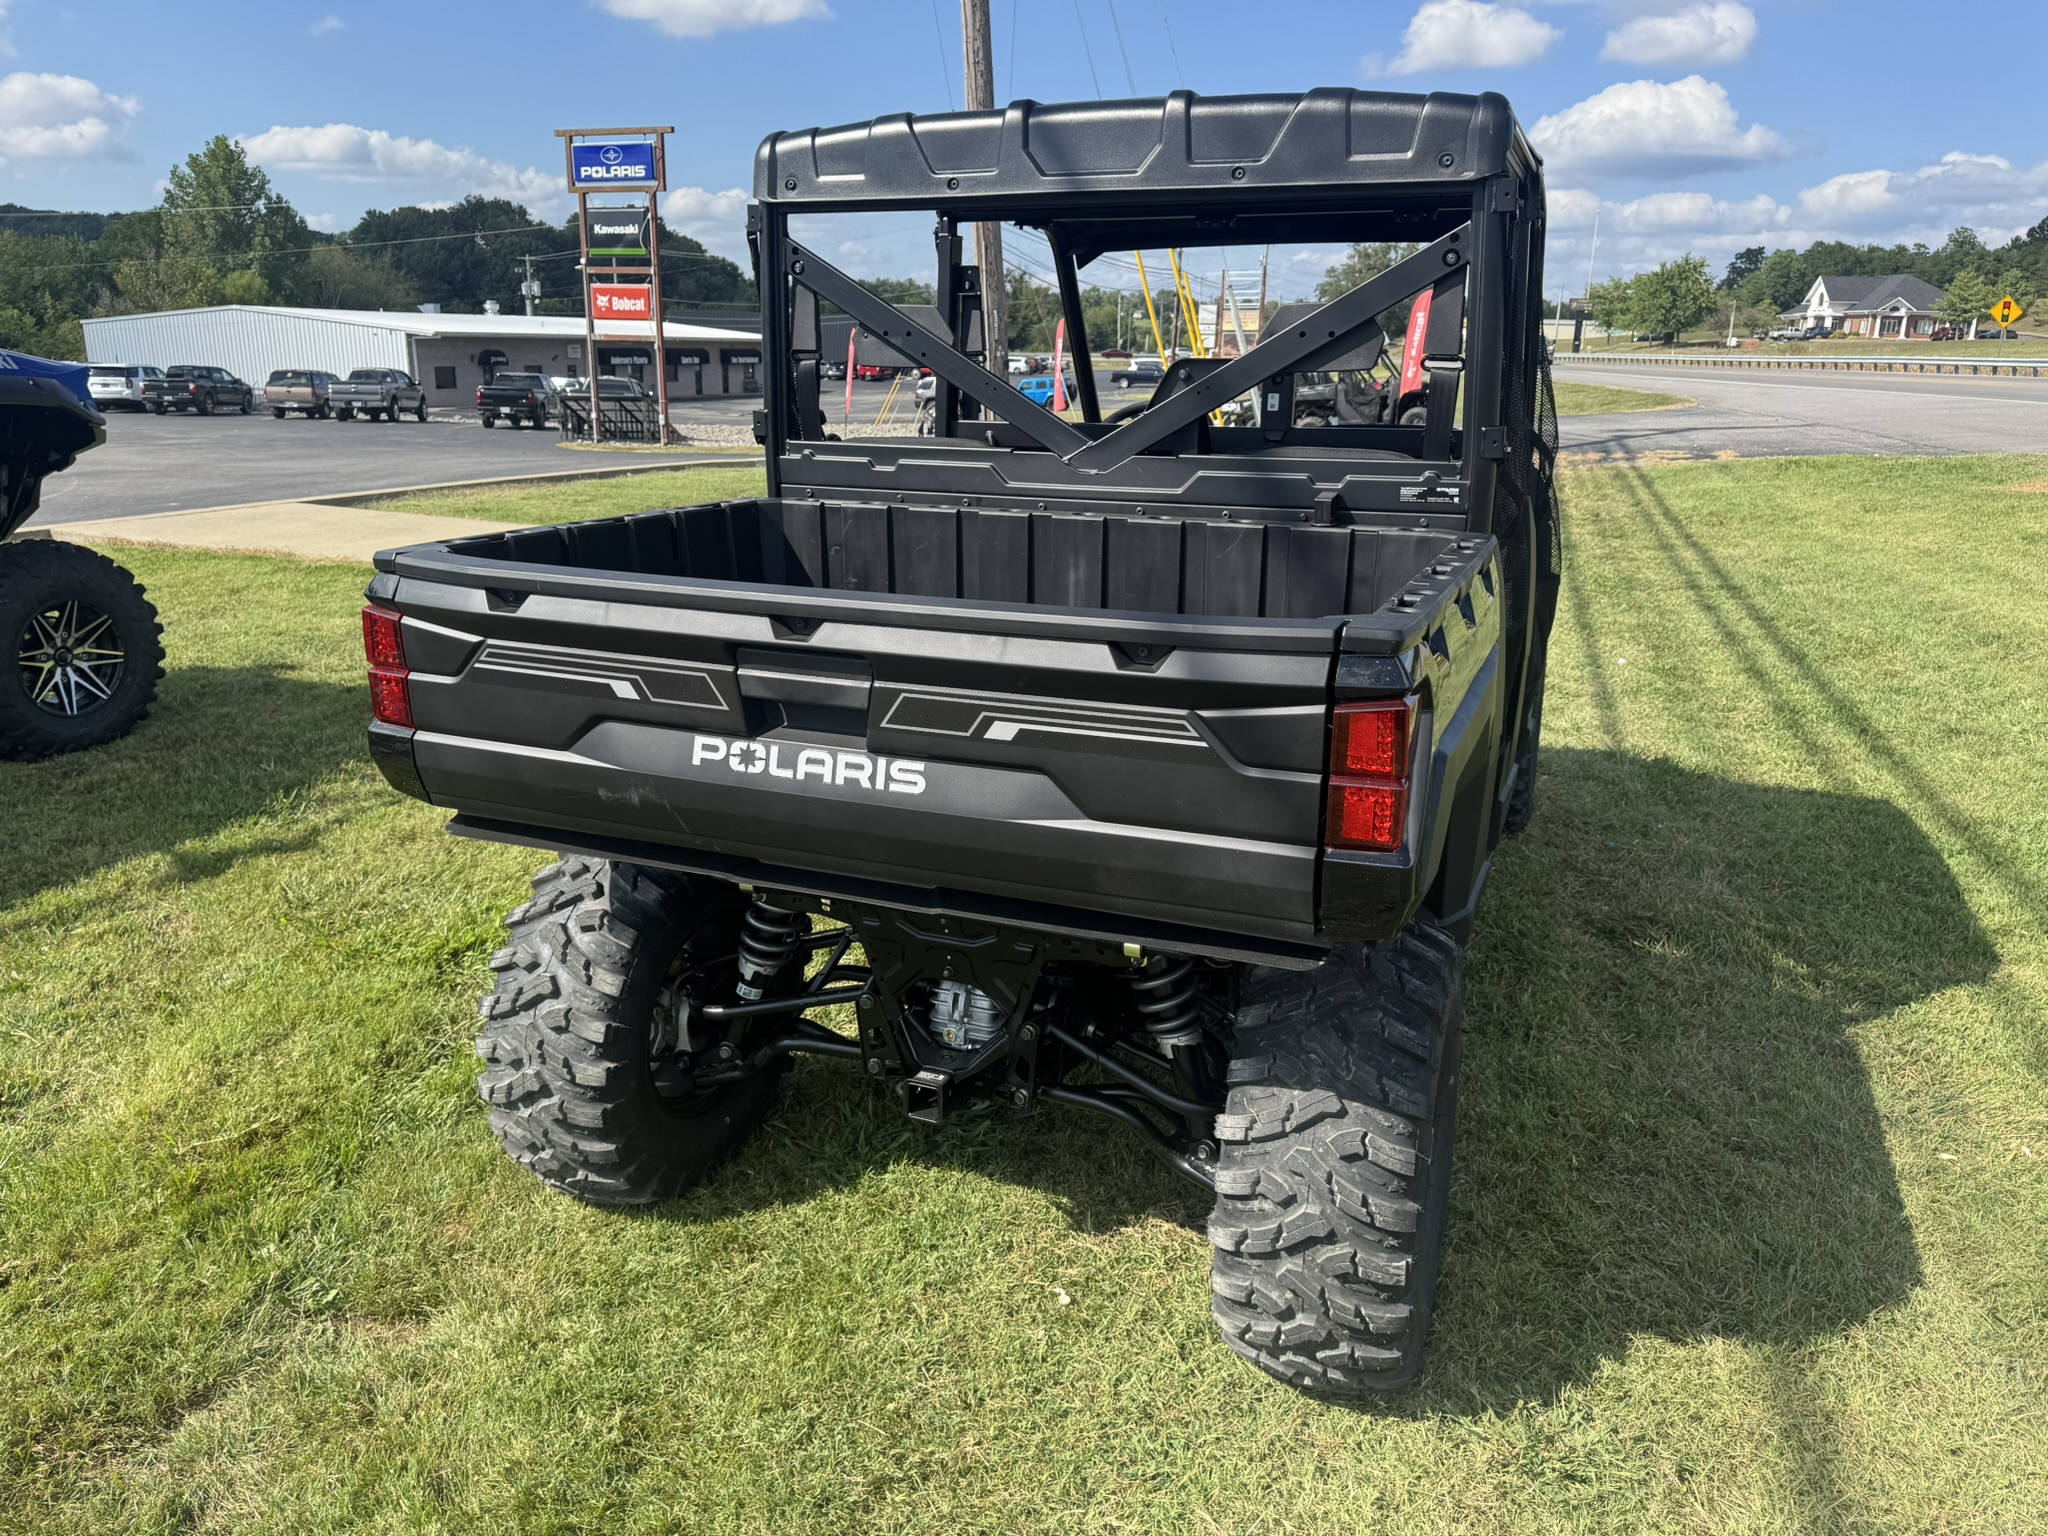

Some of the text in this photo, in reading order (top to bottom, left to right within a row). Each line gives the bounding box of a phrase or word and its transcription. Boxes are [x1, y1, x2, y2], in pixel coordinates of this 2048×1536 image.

[580, 165, 646, 178] POLARIS
[593, 223, 639, 235] Kawasaki
[611, 295, 646, 311] Bobcat
[691, 734, 927, 795] POLARIS
